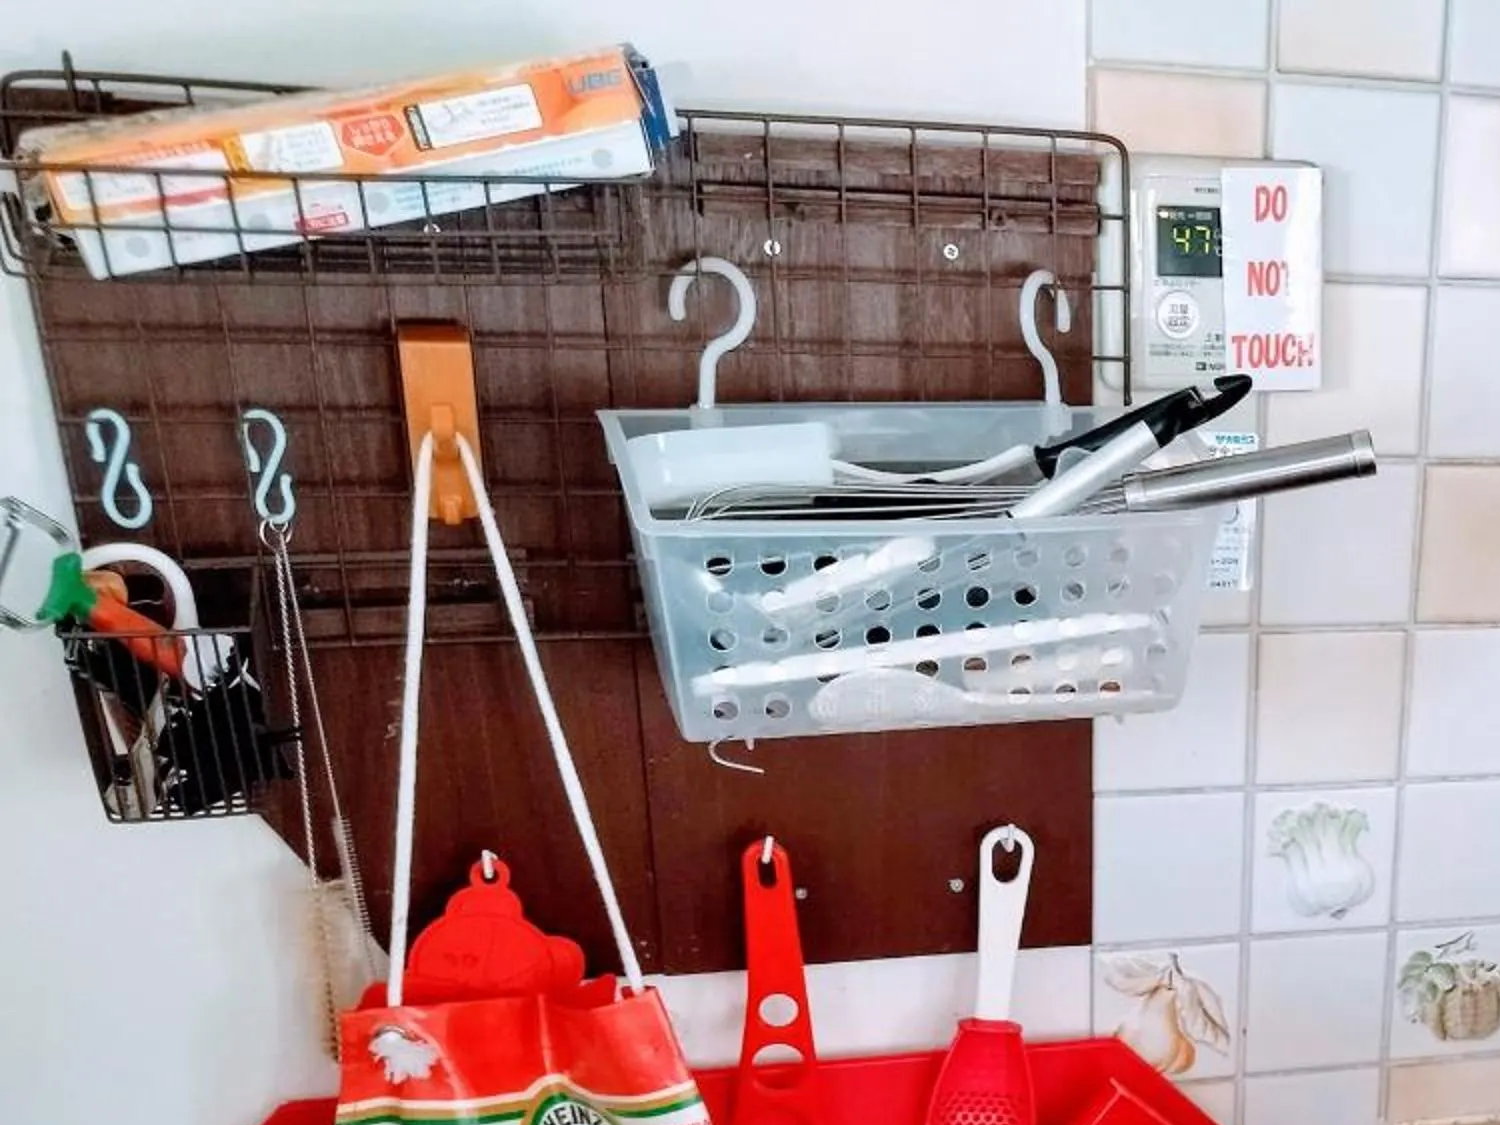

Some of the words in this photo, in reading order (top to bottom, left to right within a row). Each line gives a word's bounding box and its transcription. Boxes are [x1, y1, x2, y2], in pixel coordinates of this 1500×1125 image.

[1255, 184, 1288, 223] DO
[1172, 225, 1212, 254] 47
[1231, 333, 1314, 369] TOUCH
